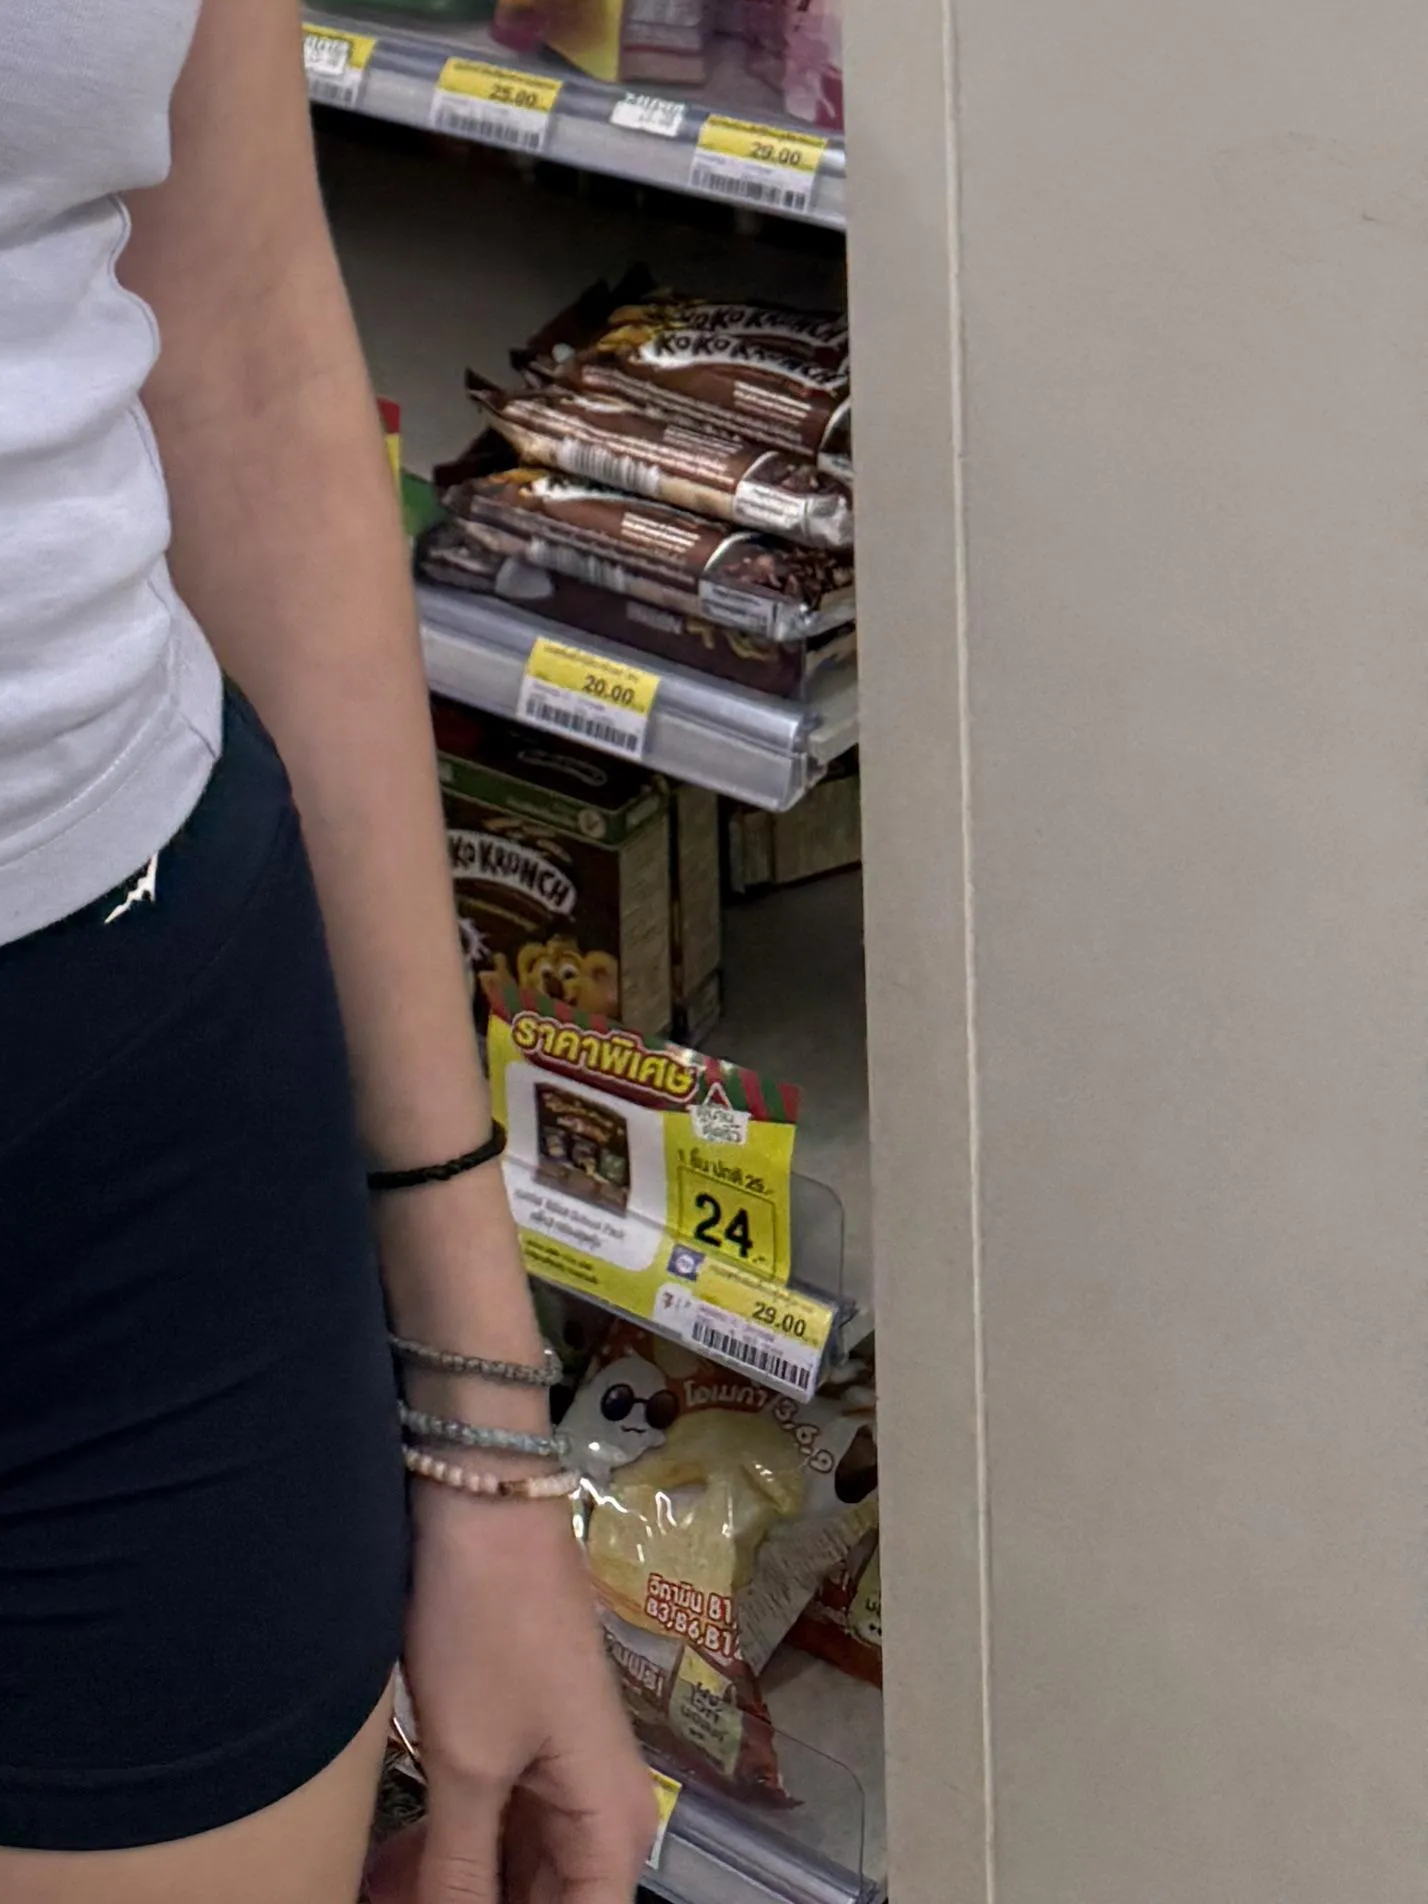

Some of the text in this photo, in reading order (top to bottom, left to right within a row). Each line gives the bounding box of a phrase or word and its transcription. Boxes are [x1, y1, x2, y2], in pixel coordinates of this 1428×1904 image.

[750, 142, 803, 167] 29.00
[582, 673, 636, 706] 20.00
[512, 1016, 696, 1096] ราคาพิเศษ
[751, 1301, 807, 1338] 29.00
[648, 1572, 705, 1614] วิตามิน
